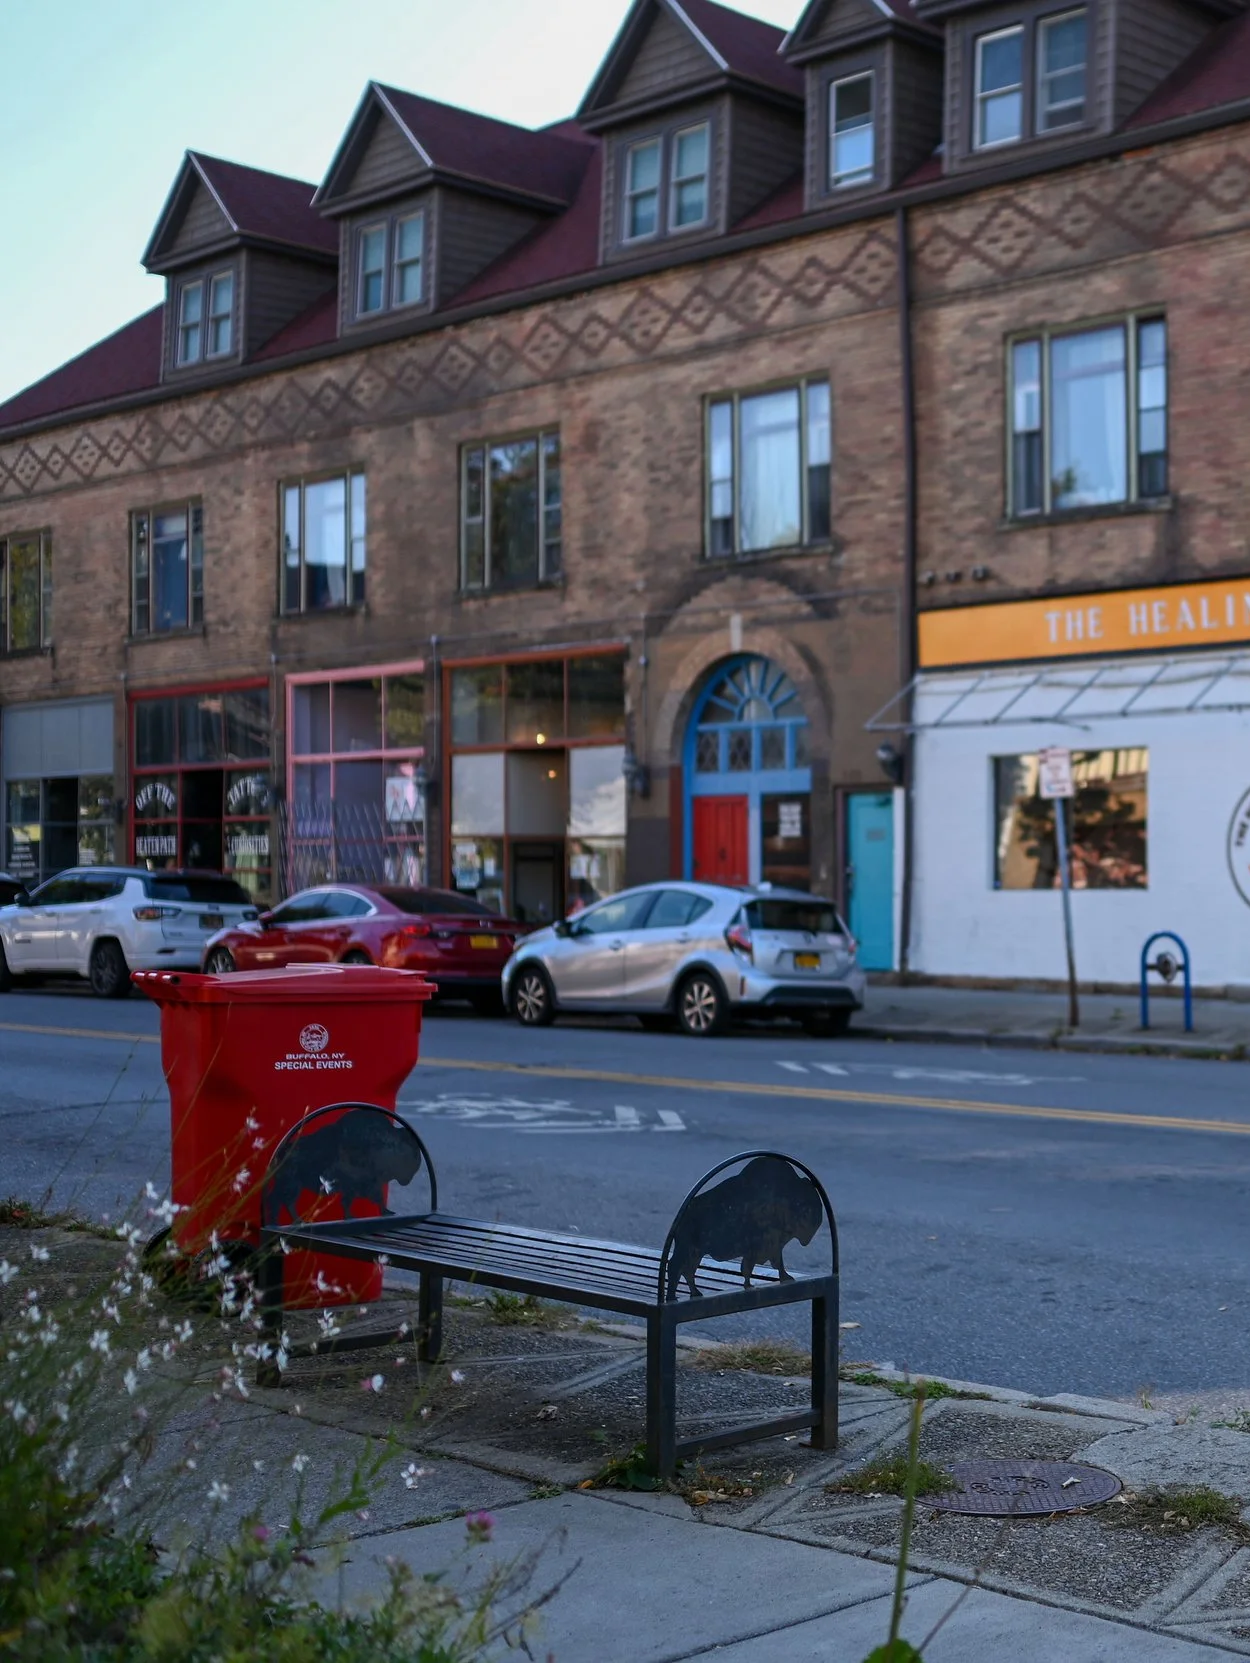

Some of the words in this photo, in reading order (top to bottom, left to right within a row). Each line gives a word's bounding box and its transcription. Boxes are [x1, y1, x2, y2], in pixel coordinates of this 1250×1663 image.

[1044, 606, 1104, 644] THE
[274, 1061, 315, 1070] SPECIAL
[316, 1060, 353, 1069] EVENTS
